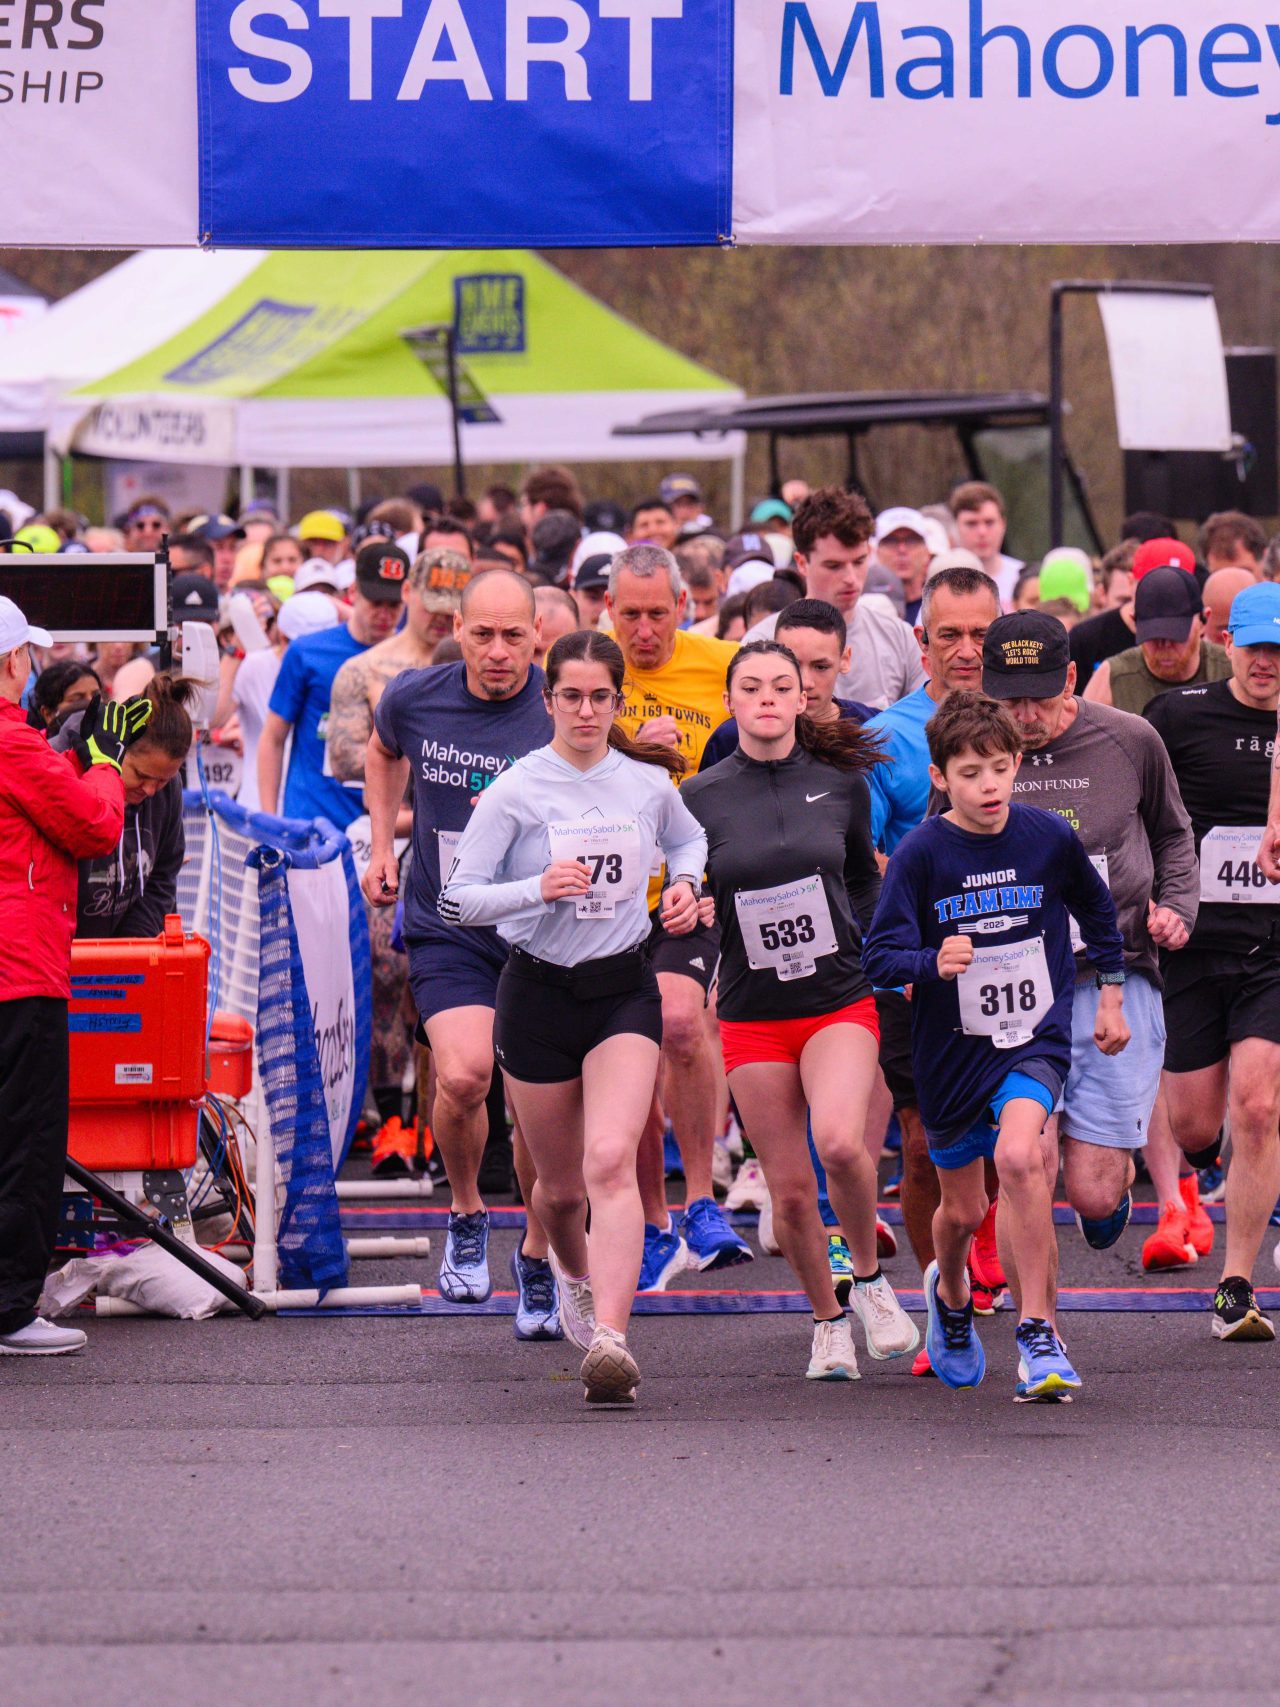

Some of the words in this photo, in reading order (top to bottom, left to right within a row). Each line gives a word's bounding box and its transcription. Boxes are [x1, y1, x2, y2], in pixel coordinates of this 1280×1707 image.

[228, 0, 683, 102] START
[1001, 641, 1011, 650] THE
[1011, 640, 1029, 648] BLACK
[1029, 640, 1044, 650] KEYS
[1005, 656, 1024, 665] WORLD
[1024, 656, 1040, 665] TOUR
[620, 705, 637, 717] UN
[642, 705, 662, 717] 169
[665, 706, 712, 729] TOWNS
[421, 739, 507, 775] Mahoney
[422, 762, 468, 788] Sabol
[1011, 780, 1042, 793] RON
[1045, 777, 1090, 791] FUNDS
[554, 824, 615, 837] MahoneySabol
[622, 824, 634, 832] 5K
[1206, 832, 1262, 842] MahoneySabol
[962, 868, 1017, 888] JUNIOR
[1217, 860, 1267, 888] 446
[740, 888, 800, 907] MahoneySabol
[806, 883, 819, 893] 5K
[759, 914, 816, 951] 533
[983, 920, 1005, 930] 2025
[973, 949, 1024, 964] ahoneySabol
[1030, 946, 1040, 955] 5K
[979, 979, 1037, 1017] 318
